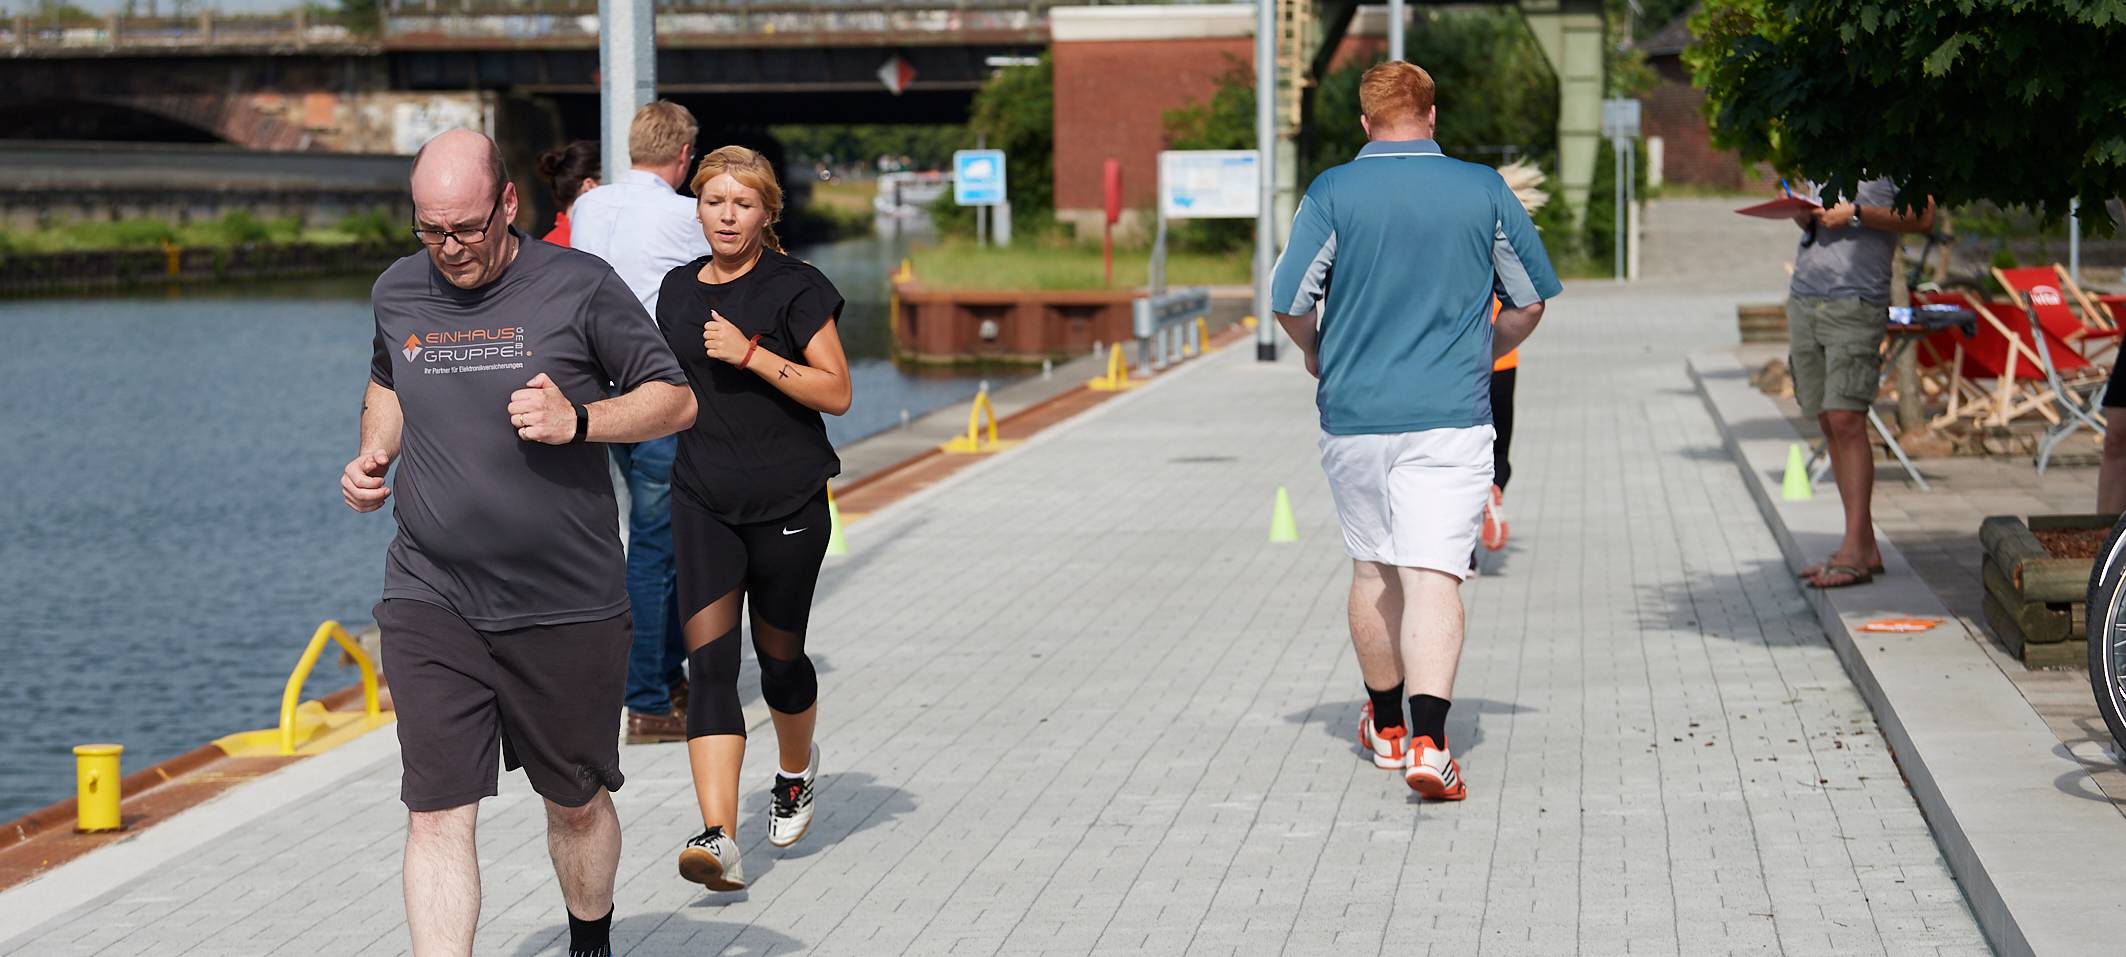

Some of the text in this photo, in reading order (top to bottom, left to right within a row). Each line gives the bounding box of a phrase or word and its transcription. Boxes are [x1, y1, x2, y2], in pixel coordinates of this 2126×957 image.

[425, 327, 515, 344] EINHAUS
[424, 345, 514, 362] GRUPPE
[432, 366, 450, 374] Partner
[459, 362, 523, 373] Elektronikversicherungen
